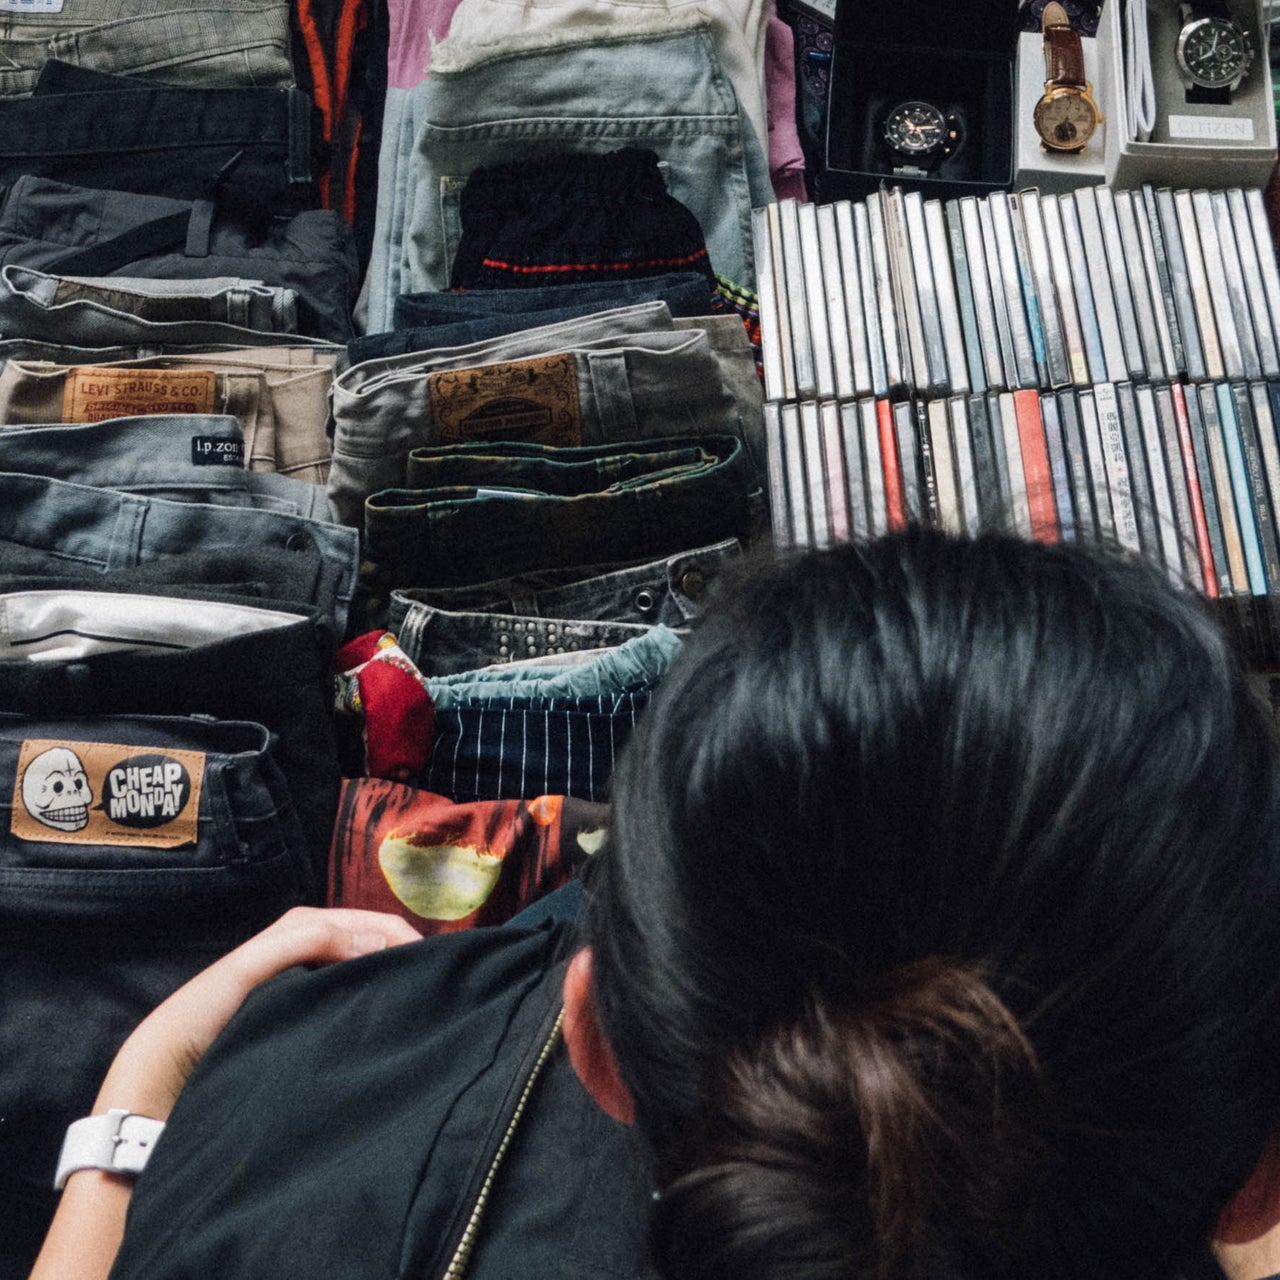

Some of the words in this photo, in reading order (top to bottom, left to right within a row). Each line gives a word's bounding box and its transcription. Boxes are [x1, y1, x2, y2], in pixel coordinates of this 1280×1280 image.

[81, 382, 109, 397] LEVI
[114, 381, 167, 396] STRAUSS
[170, 386, 180, 397] &
[182, 385, 203, 398] CO.
[1249, 446, 1260, 478] FRIENDLY
[1255, 479, 1264, 498] FIRES
[109, 763, 182, 798] CHEAP
[110, 783, 184, 819] MONDAY
